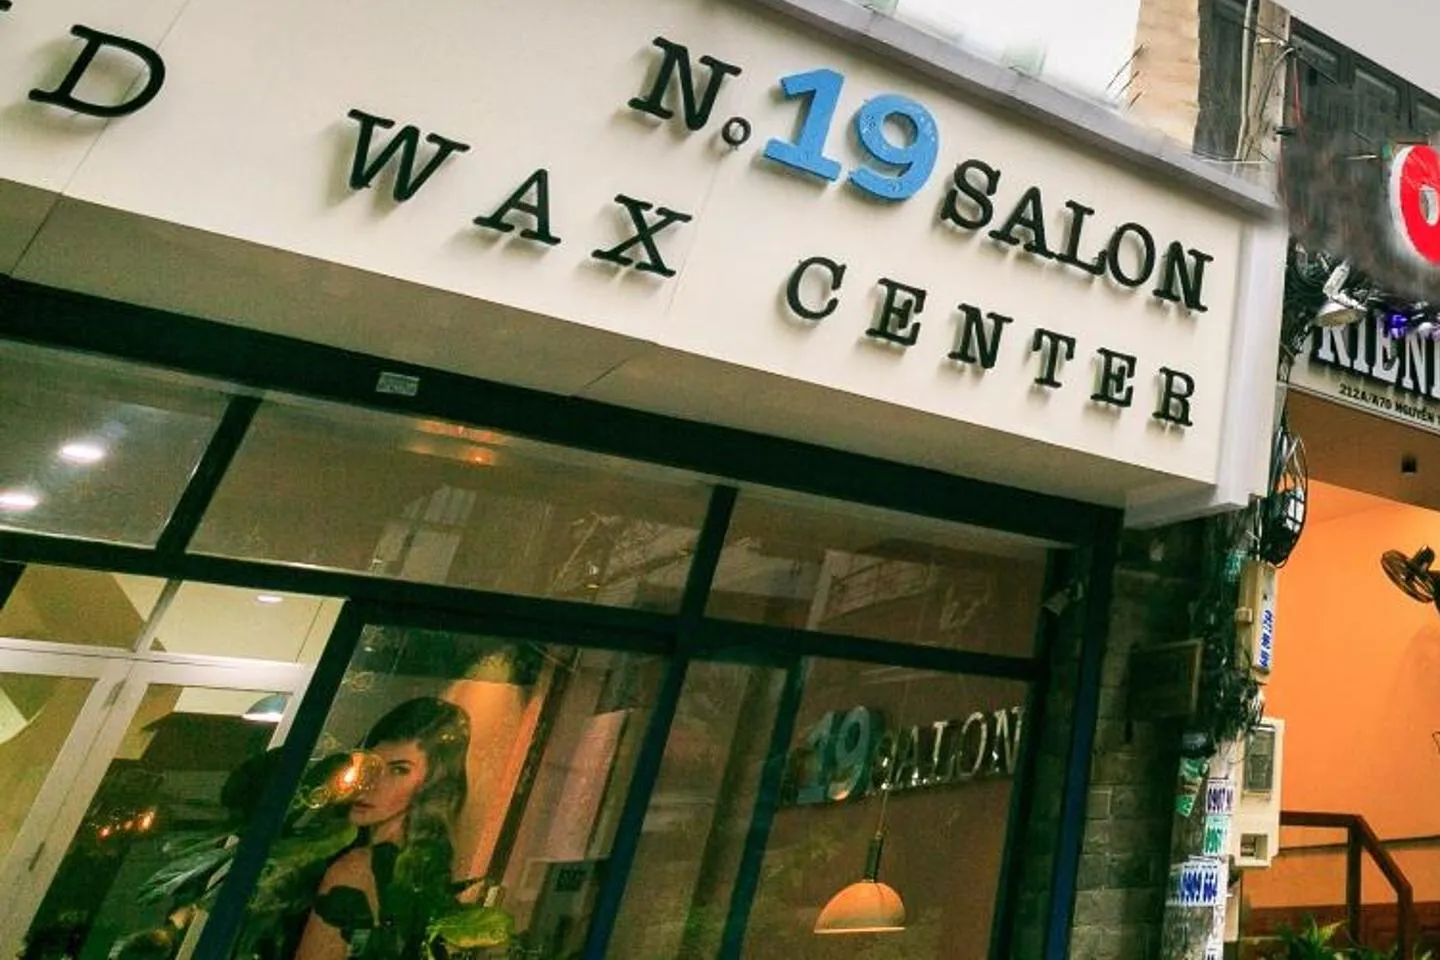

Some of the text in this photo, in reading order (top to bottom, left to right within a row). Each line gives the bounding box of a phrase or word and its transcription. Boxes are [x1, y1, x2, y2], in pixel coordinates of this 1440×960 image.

[348, 108, 692, 277] WAX
[786, 257, 1196, 427] CENTER
[763, 68, 940, 201] 19
[940, 159, 1214, 312] SALON
[797, 705, 872, 805] 19
